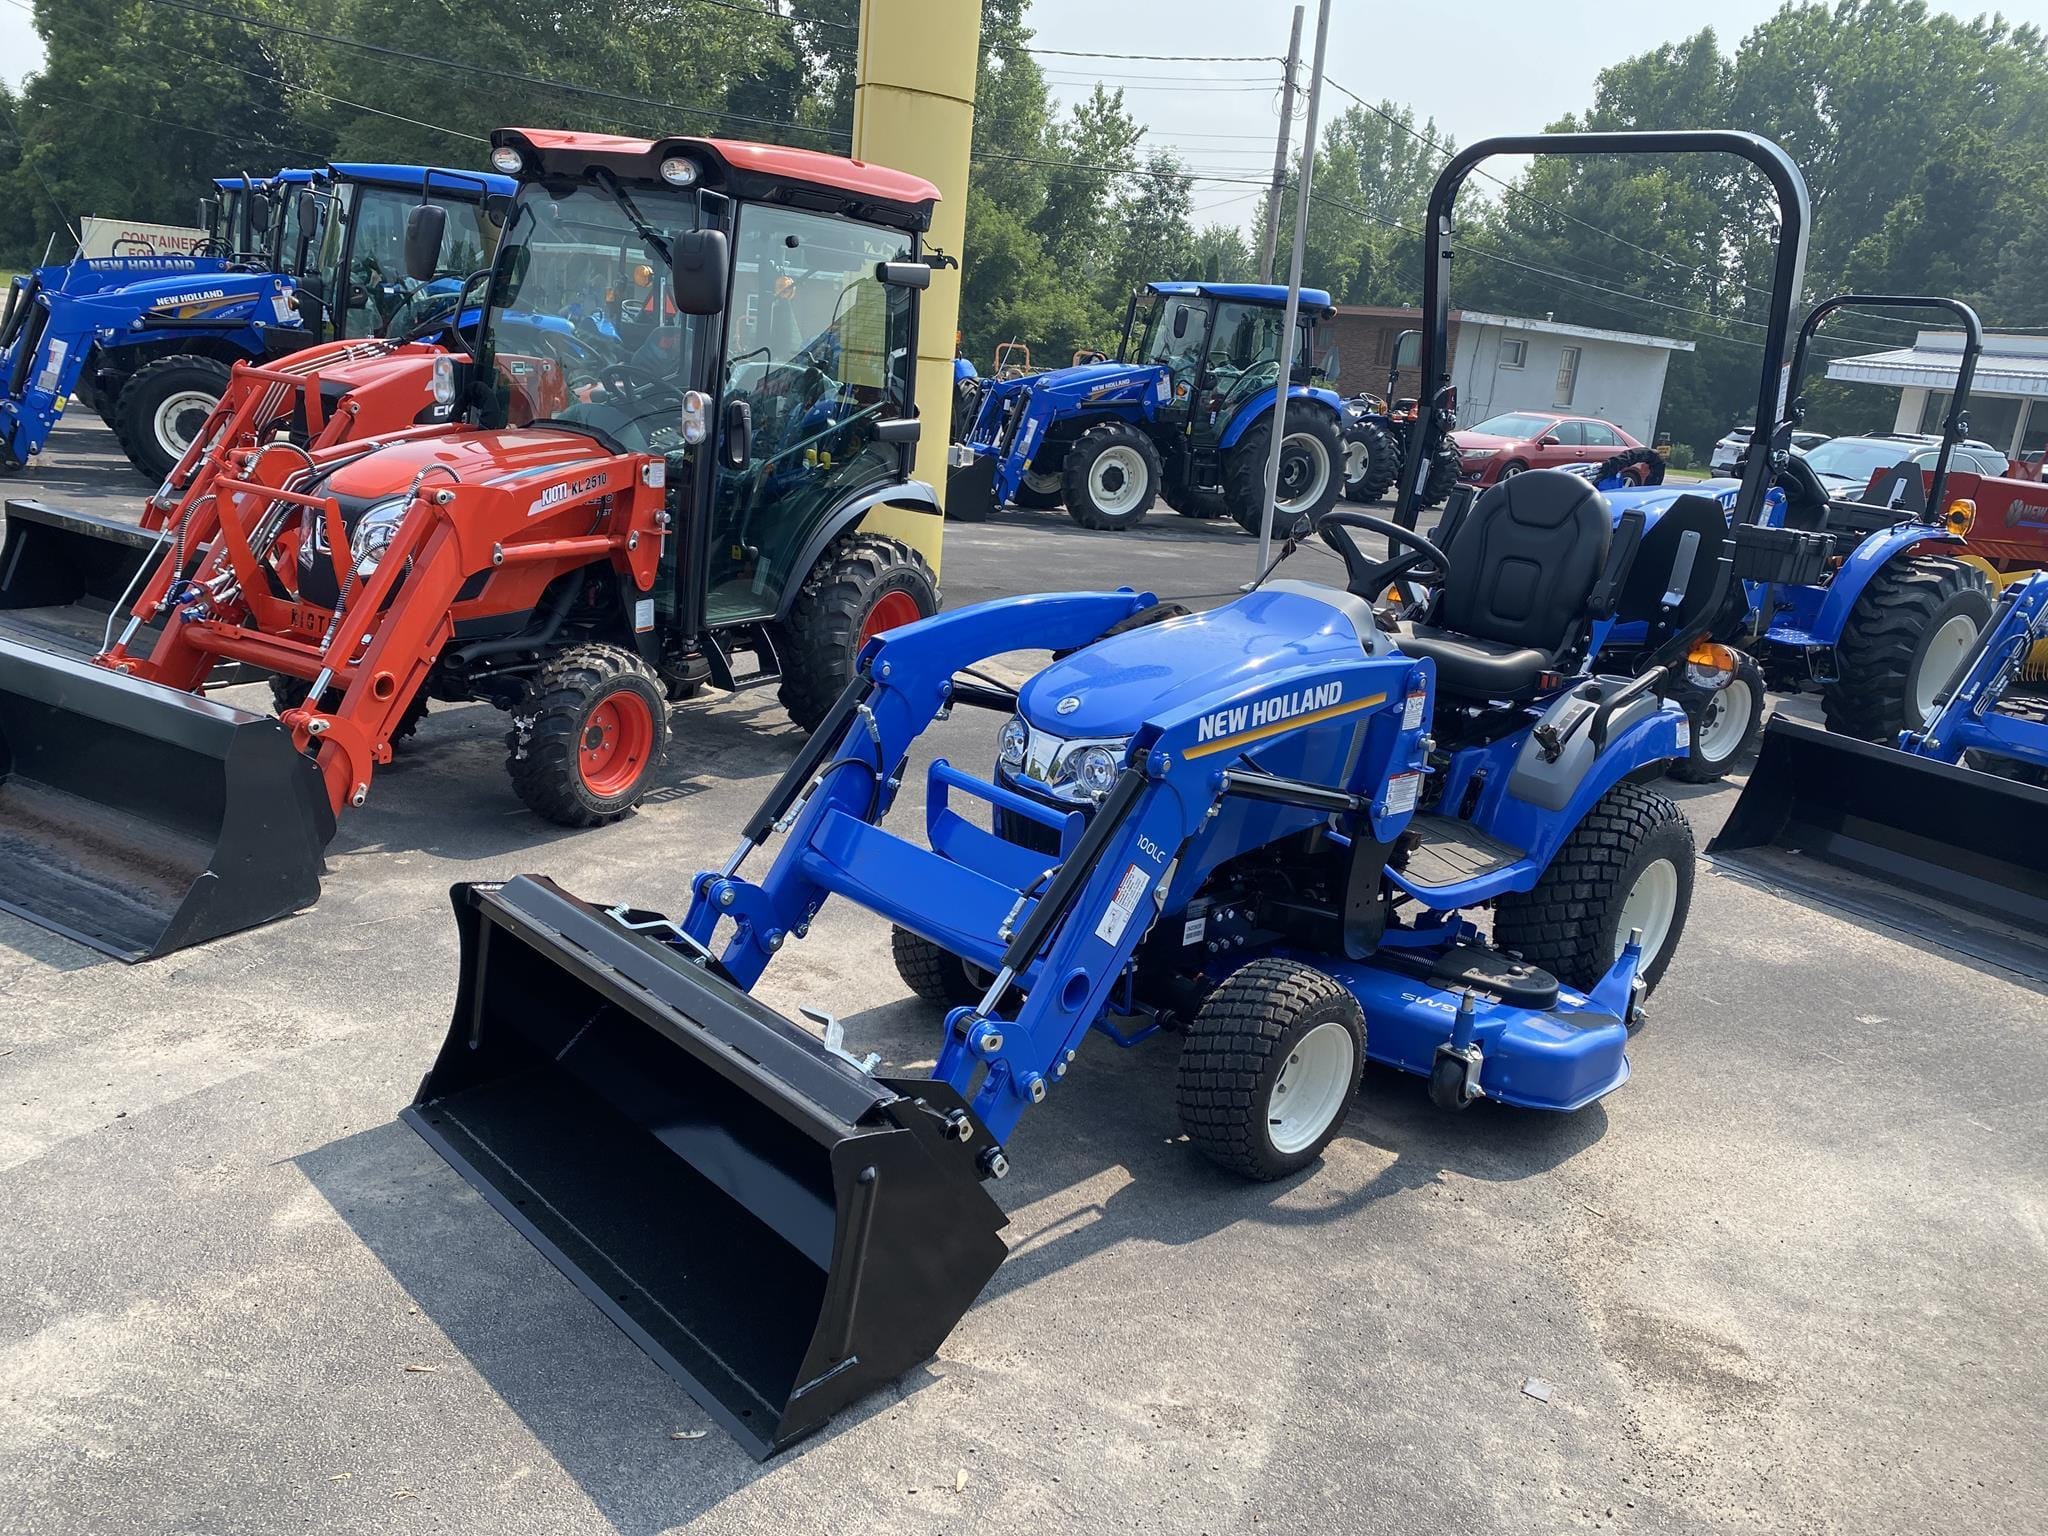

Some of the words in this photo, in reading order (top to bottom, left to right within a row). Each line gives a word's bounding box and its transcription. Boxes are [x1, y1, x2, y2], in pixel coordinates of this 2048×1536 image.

[89, 259, 123, 271] NEW
[127, 259, 196, 271] HOLLAND
[156, 296, 180, 307] NEW
[180, 289, 224, 303] HOLLAND
[1105, 378, 1130, 389] HOLLAND
[541, 482, 568, 506] KIOTI
[571, 481, 583, 496] KL
[585, 472, 607, 491] 2510
[1198, 704, 1249, 742] NEW
[1251, 680, 1343, 727] HOLLAND
[1136, 833, 1166, 864] 100LC
